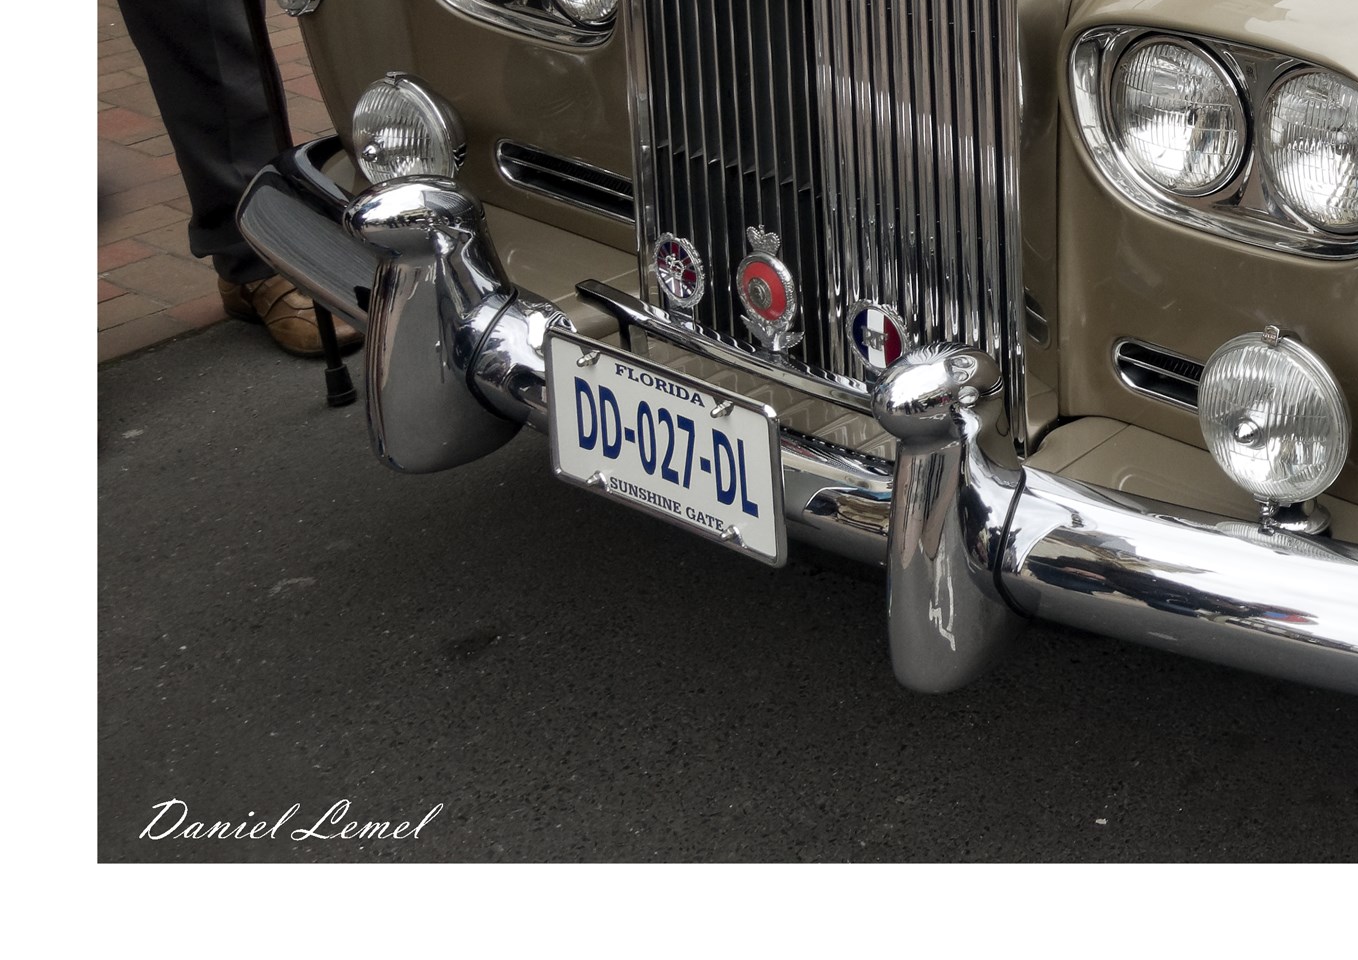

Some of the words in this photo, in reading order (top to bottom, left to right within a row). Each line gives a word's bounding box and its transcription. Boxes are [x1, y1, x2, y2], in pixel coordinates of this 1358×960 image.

[614, 362, 706, 408] FLORIDA
[574, 376, 759, 518] DD-027-DL
[609, 476, 682, 515] SUNSHINE
[686, 506, 726, 532] GATE
